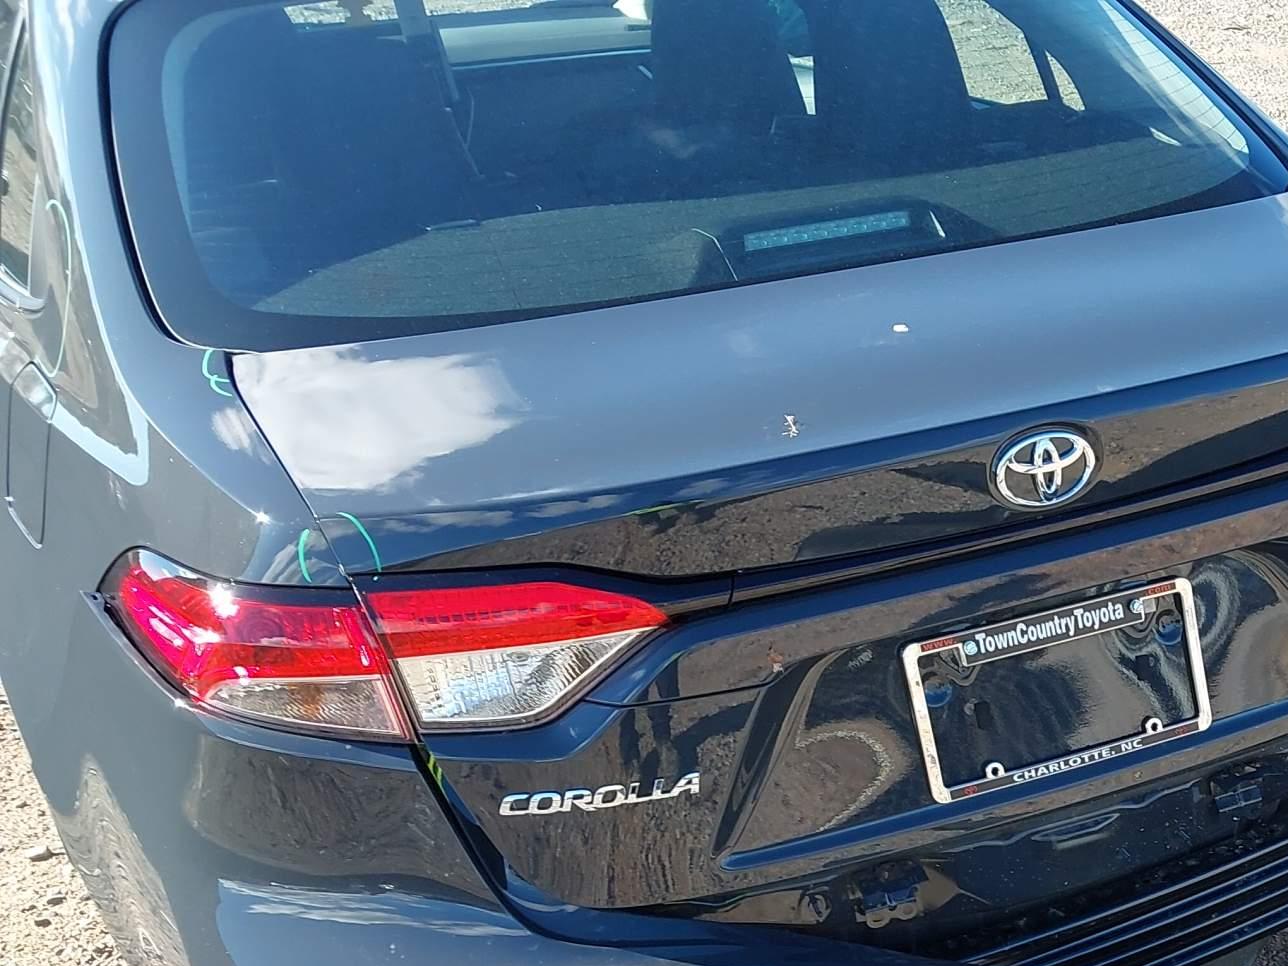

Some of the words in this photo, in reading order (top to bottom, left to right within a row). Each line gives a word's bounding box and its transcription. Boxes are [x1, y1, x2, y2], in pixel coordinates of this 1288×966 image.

[975, 601, 1125, 655] TownCountryToyota
[1121, 738, 1144, 753] NC
[498, 771, 701, 816] COROLLA
